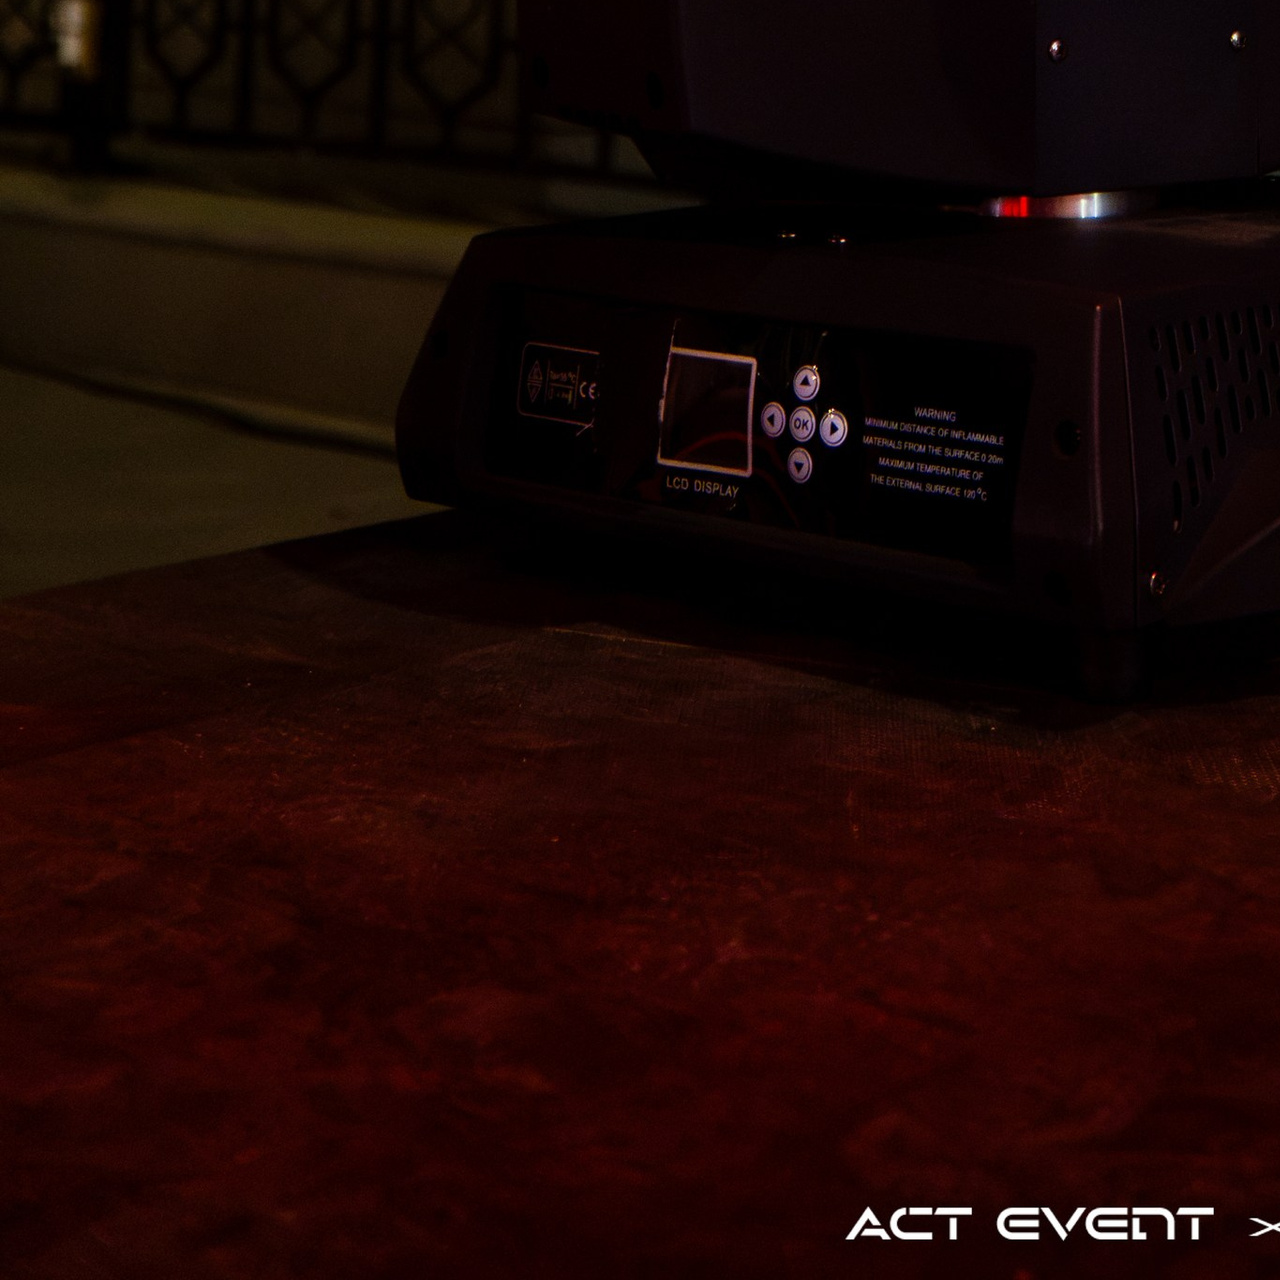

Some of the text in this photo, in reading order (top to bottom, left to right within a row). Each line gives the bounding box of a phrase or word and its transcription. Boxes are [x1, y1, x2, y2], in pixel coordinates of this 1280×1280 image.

[793, 417, 809, 431] OK
[914, 405, 957, 422] WARNING
[864, 416, 1005, 446] MINIMUM DISTANCE OF INFLAMMABLE
[862, 434, 903, 451] MATERIALS
[903, 441, 926, 454] FROM
[928, 445, 943, 456] THE
[944, 448, 980, 462] SURFACE
[878, 456, 984, 481] MAXIMUM TEMPERATURE OF
[666, 475, 740, 498] LCD DISPLAY
[870, 473, 885, 484] THE
[886, 476, 923, 491] EXTERNAL
[925, 483, 961, 497] SURFACE
